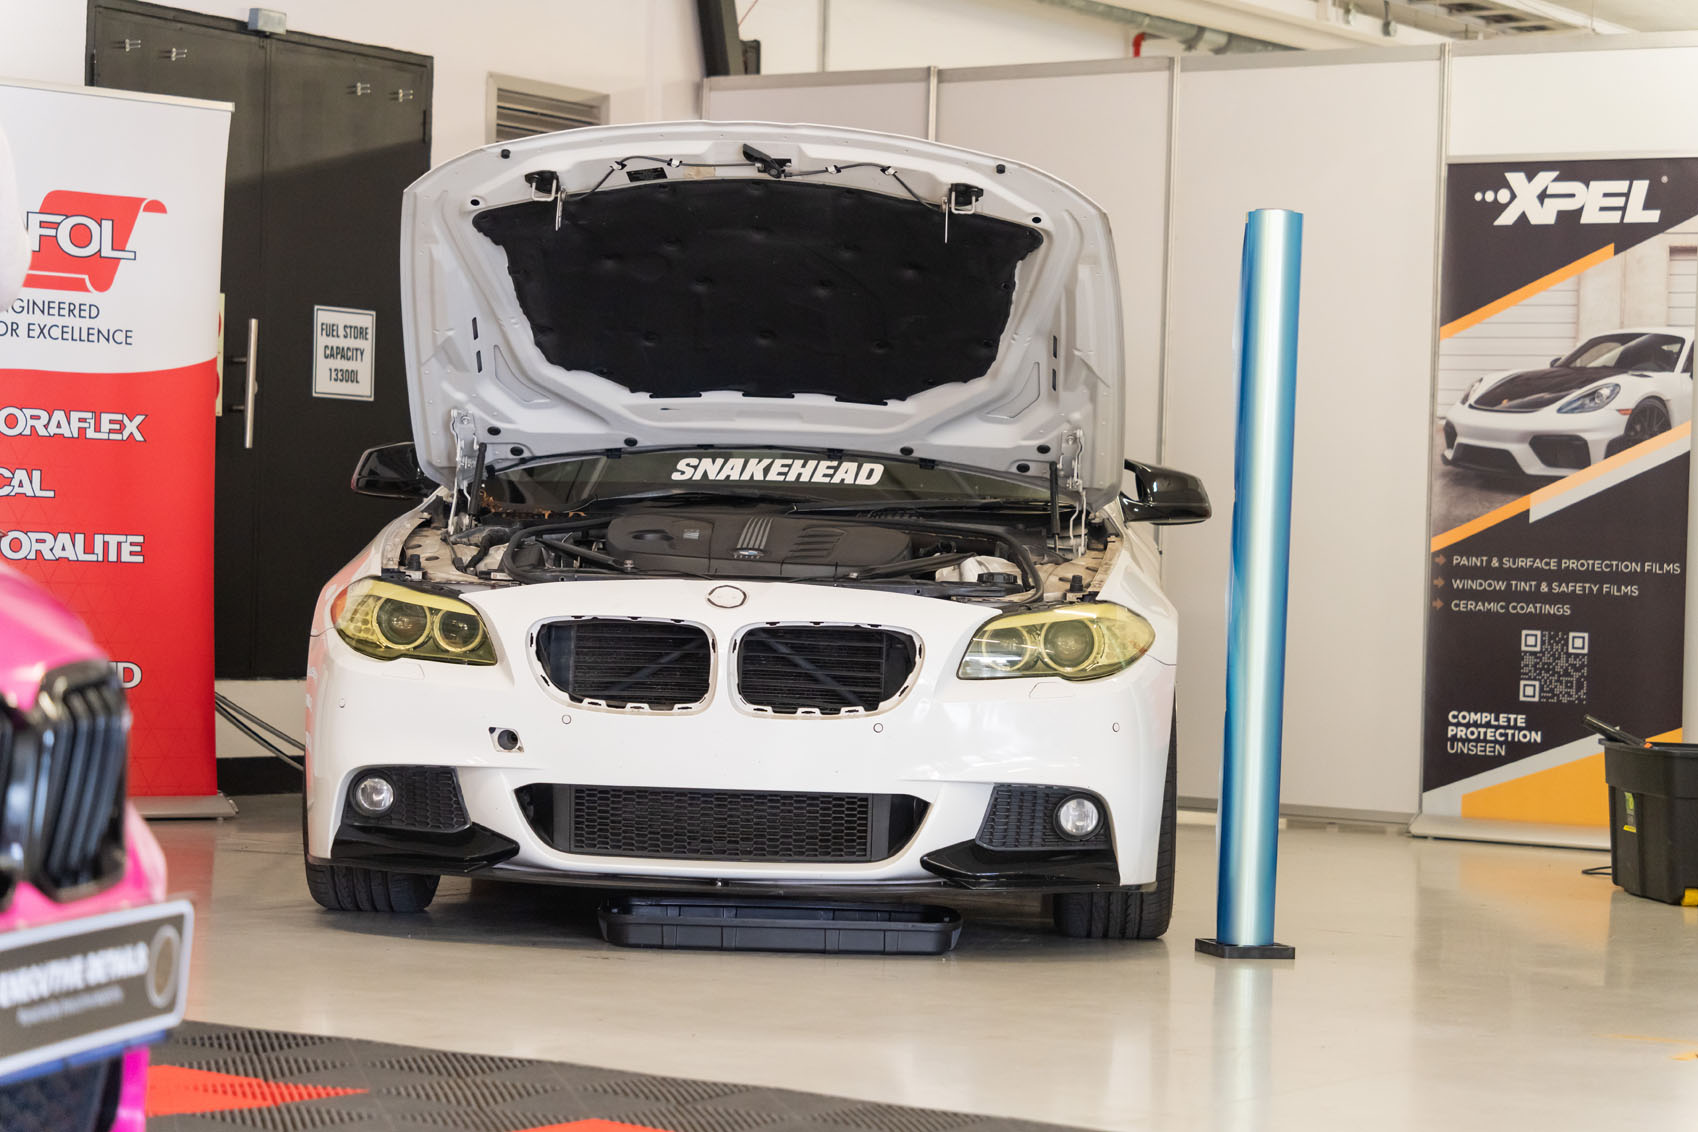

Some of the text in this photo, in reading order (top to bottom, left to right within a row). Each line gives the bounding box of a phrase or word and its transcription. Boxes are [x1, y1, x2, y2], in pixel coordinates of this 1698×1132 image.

[1493, 171, 1661, 226] XPEL
[27, 211, 136, 261] FOL
[11, 298, 100, 319] GINEERED
[0, 320, 133, 346] OR EXCELLENCE
[320, 322, 369, 341] FUEL STORE
[324, 344, 365, 362] CAPACITY
[329, 368, 360, 384] 13300L
[0, 406, 148, 442] ORAFLEX
[671, 457, 885, 486] SNAKEHEAD
[0, 467, 55, 498] CAL
[0, 530, 144, 563] ORALITE
[1452, 555, 1681, 574] PAINT & SURFACE PROTECTION FILMS
[1452, 578, 1639, 596] WINDOW TINT & SAFETY FILMS
[1451, 600, 1571, 616] CERAMIC COATINGS
[1448, 711, 1526, 727] COMPLETE
[1447, 726, 1541, 744] PROTECTION
[1447, 741, 1506, 756] UNSEEN
